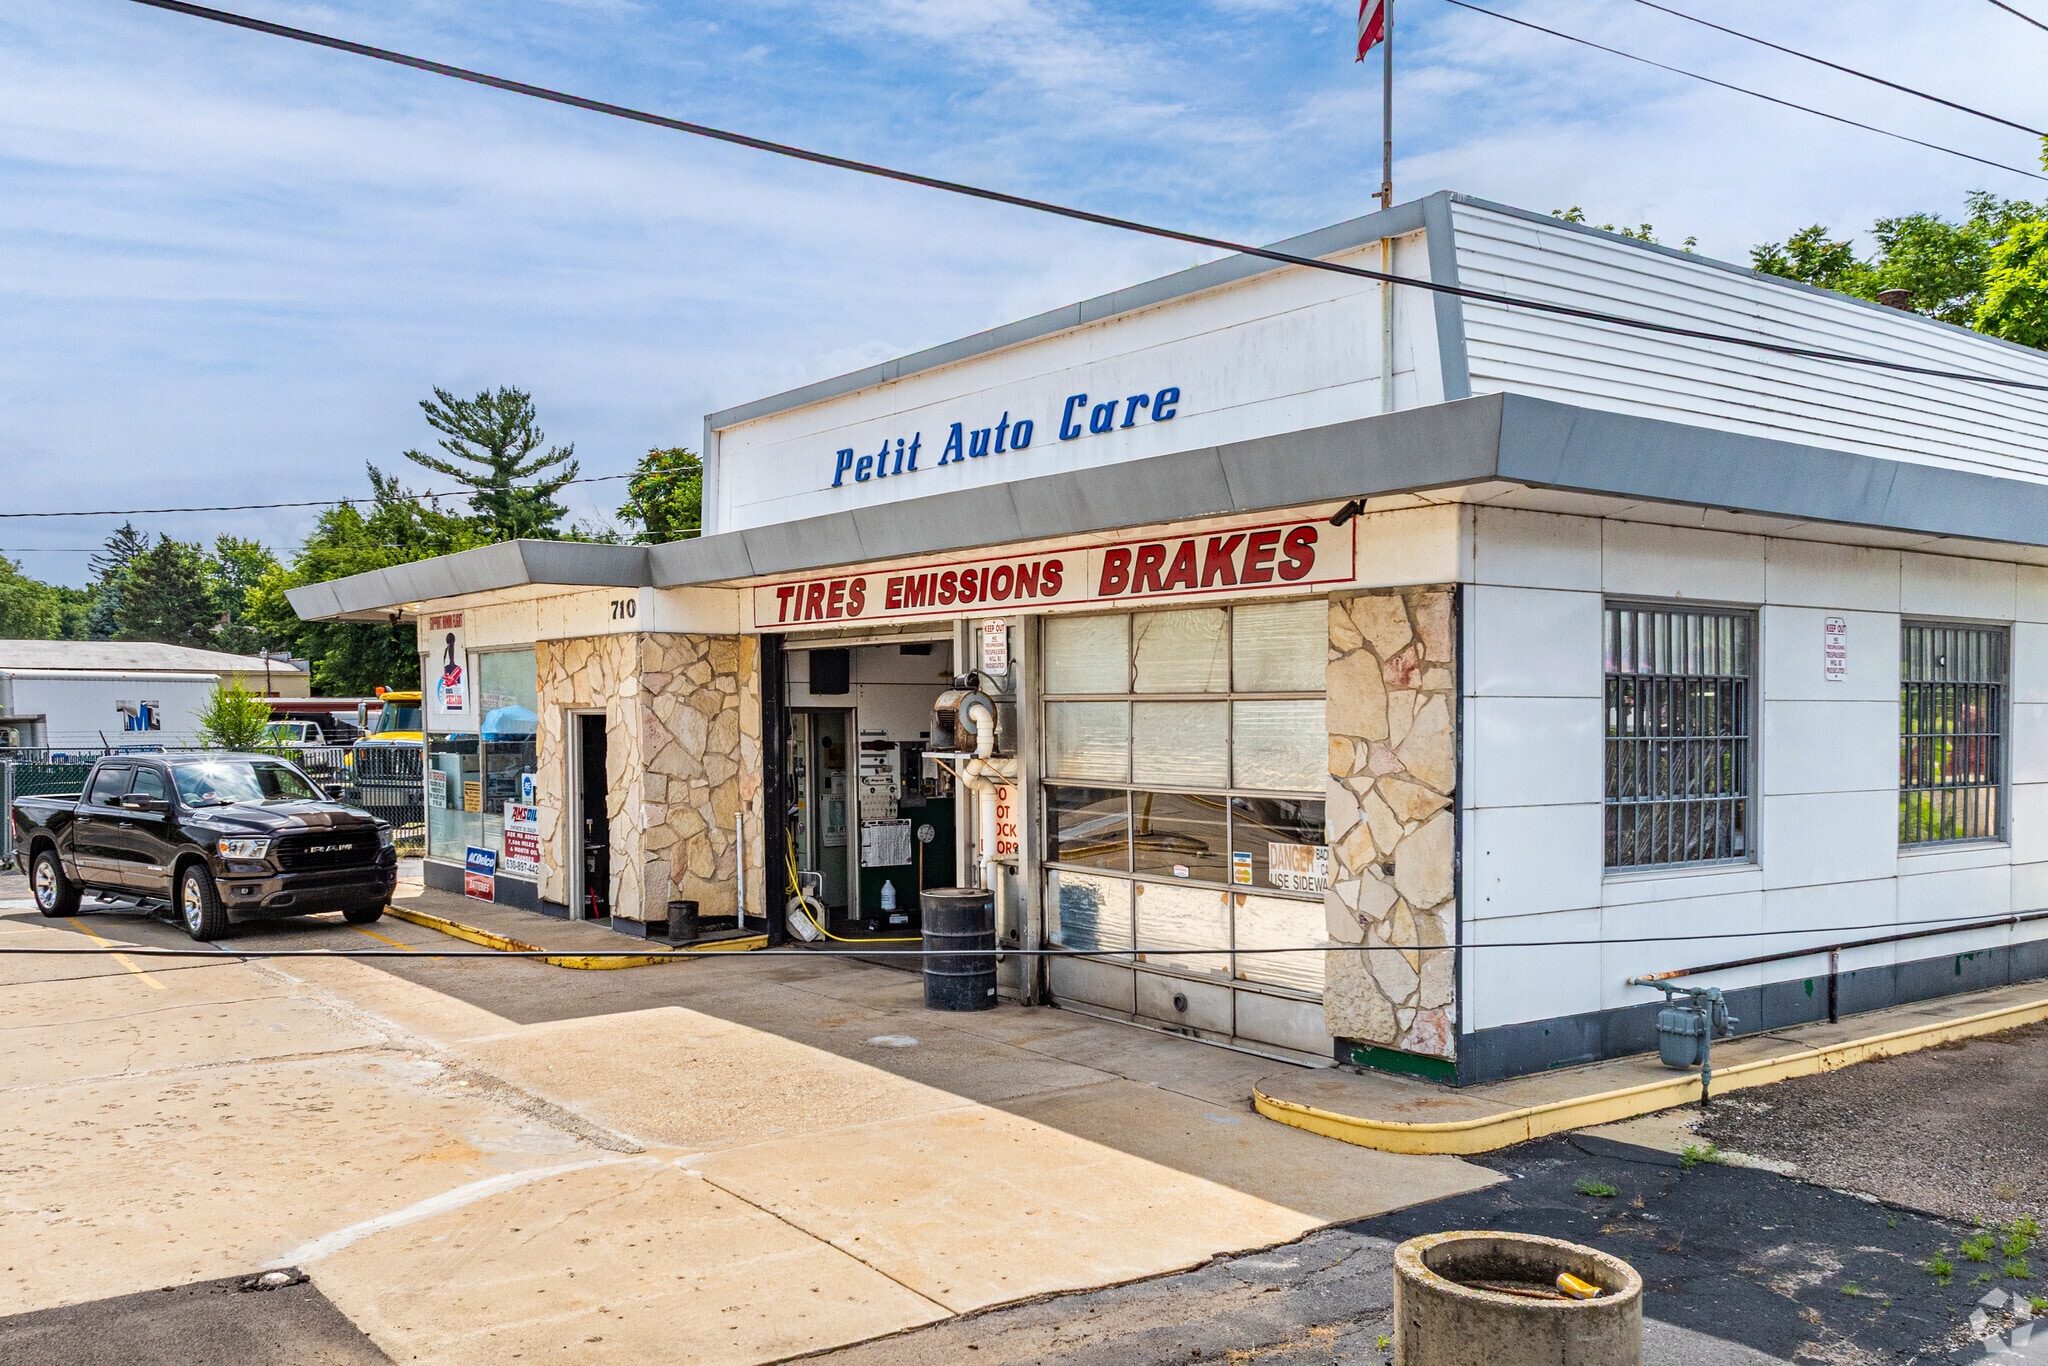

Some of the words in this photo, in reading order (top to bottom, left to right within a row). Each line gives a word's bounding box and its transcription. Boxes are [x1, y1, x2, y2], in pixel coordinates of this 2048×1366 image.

[831, 431, 921, 488] Petit
[938, 411, 1034, 466] Auto
[1058, 387, 1180, 441] Care
[776, 577, 866, 622] TIRES
[885, 559, 1064, 609] EMISSIONS
[1098, 526, 1318, 596] BRAKES
[611, 599, 636, 620] 710
[985, 624, 994, 632] KEEP
[996, 624, 1004, 632] OUT
[1826, 624, 1836, 632] KEEP
[1837, 624, 1846, 633] OUT
[996, 787, 1007, 801] O
[512, 806, 537, 823] AMSOIL
[996, 805, 1010, 819] OT
[997, 823, 1017, 838] OCK
[311, 844, 352, 853] RAM
[468, 852, 494, 868] ACDelco
[1269, 844, 1314, 873] DANGER
[1316, 848, 1328, 860] BAC
[469, 880, 490, 893] BATTERIES
